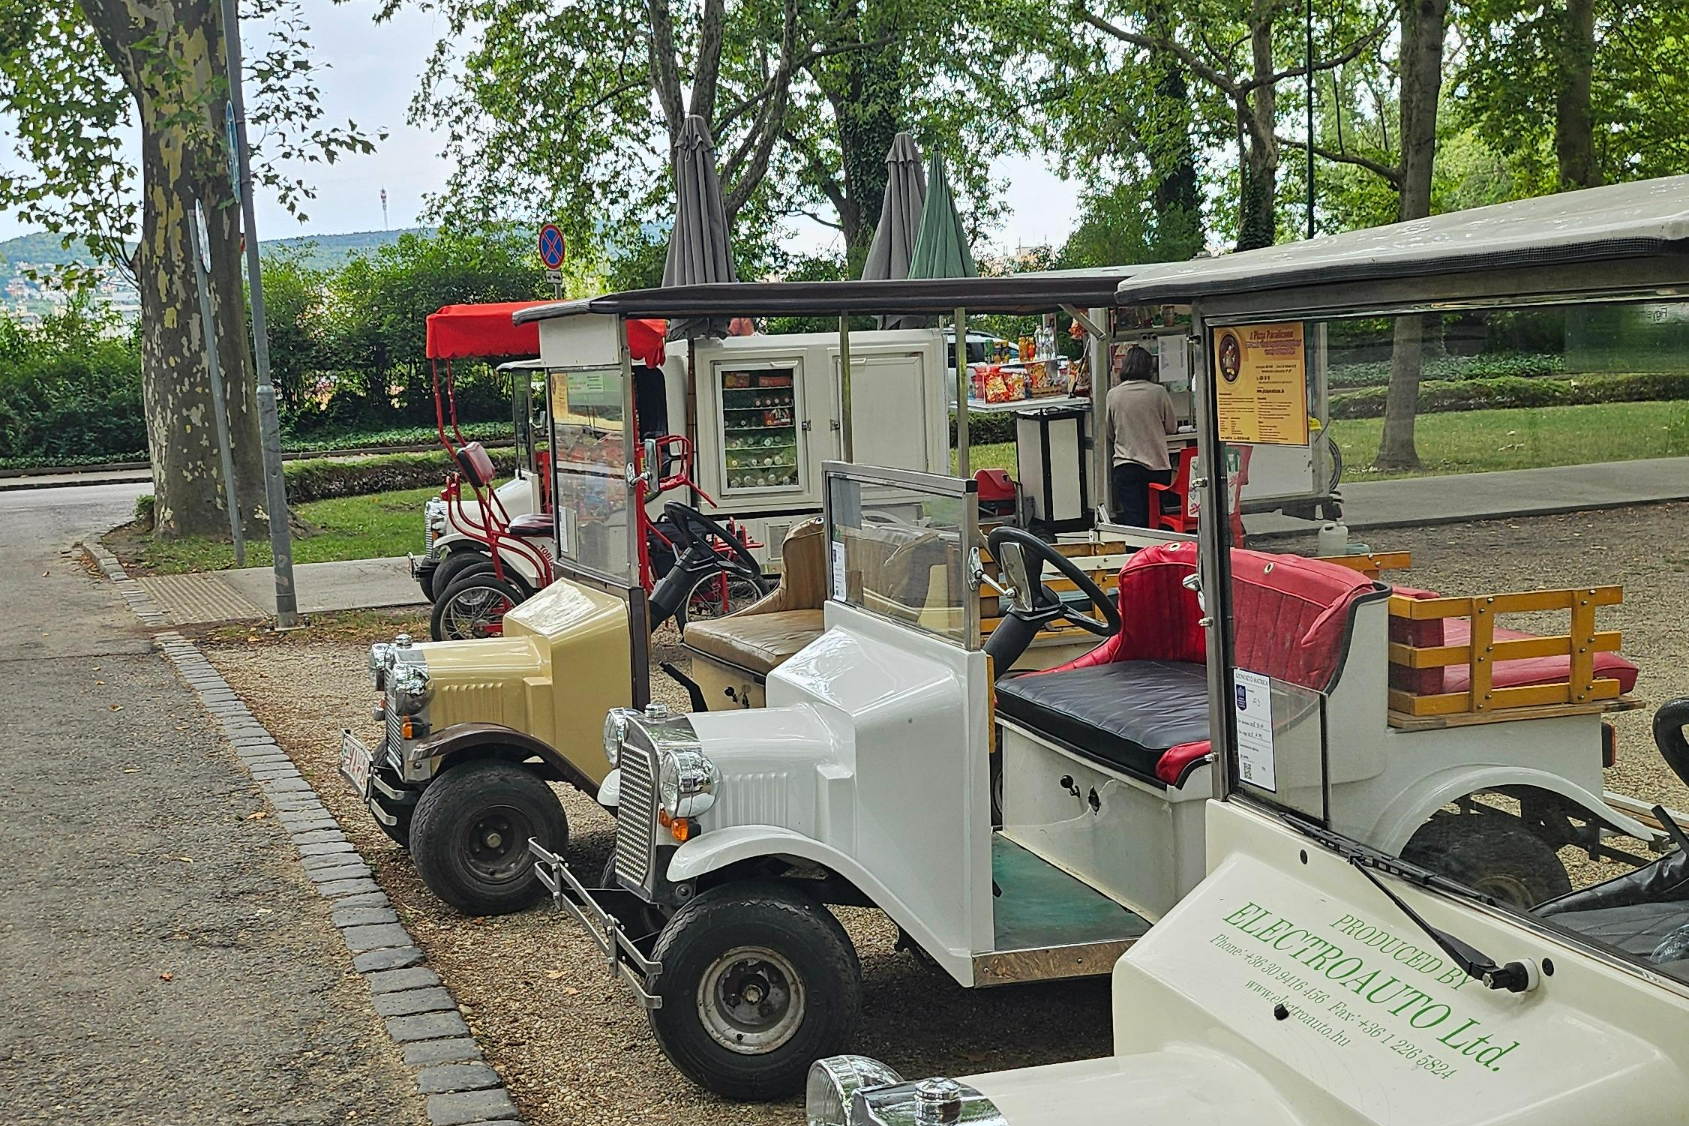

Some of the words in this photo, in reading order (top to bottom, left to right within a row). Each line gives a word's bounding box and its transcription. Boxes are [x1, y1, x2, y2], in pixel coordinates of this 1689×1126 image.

[1210, 933, 1248, 956] Phone:
[1244, 953, 1269, 968] +36
[1261, 963, 1282, 976] 30
[1275, 971, 1309, 991] 9416
[1303, 987, 1331, 1004] 456
[1327, 1001, 1361, 1022] Fax:
[1358, 1020, 1387, 1038] +36
[1380, 1033, 1396, 1044] 1
[1390, 1039, 1423, 1060] 226
[1416, 1054, 1458, 1080] 5824
[1222, 902, 1452, 1029] ELECTROAUTO
[1436, 1018, 1521, 1072] Ltd.
[1329, 914, 1443, 973] PRODUCED
[1434, 966, 1476, 991] BY
[1245, 980, 1351, 1047] www.electroauto.hu
